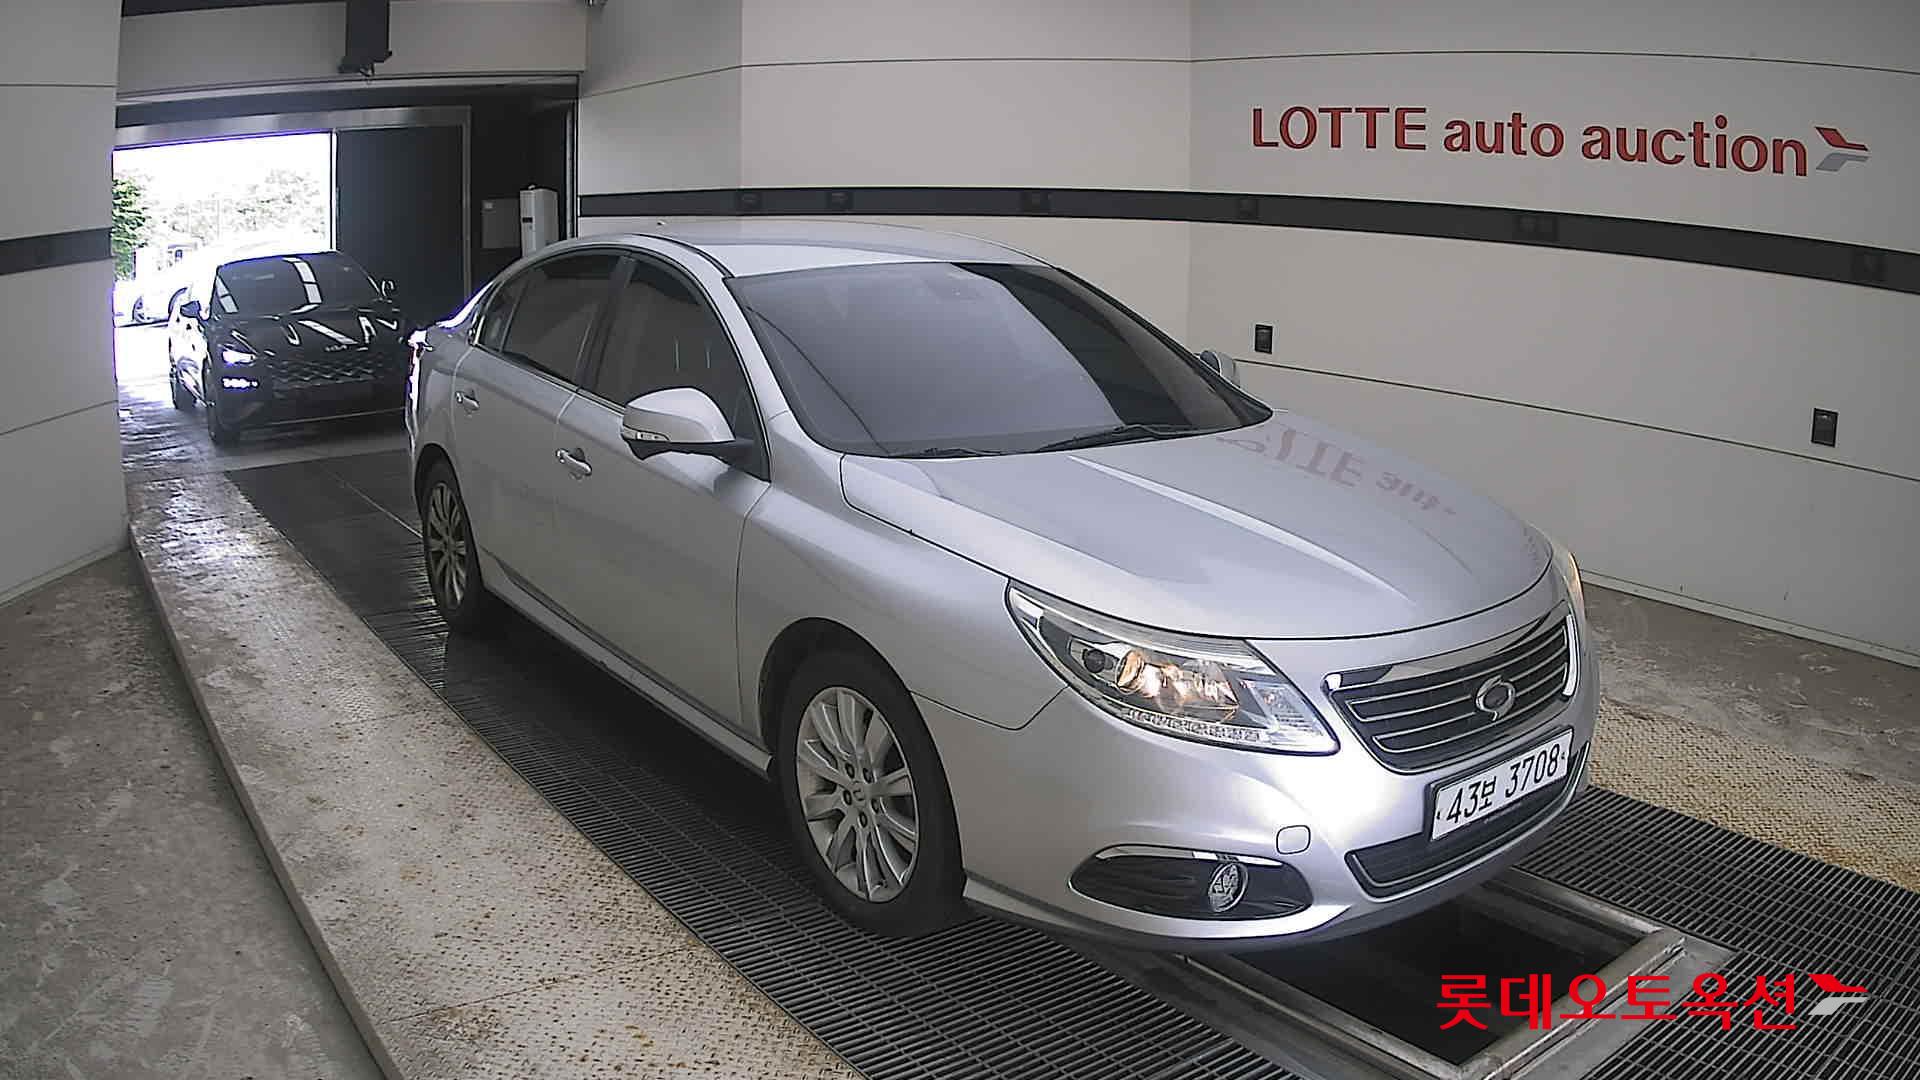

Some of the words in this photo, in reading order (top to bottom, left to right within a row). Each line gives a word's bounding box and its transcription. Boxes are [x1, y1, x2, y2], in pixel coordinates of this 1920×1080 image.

[1252, 106, 1426, 150] LOTTE
[1444, 112, 1565, 158] auto
[1581, 114, 1808, 177] auction
[1446, 776, 1497, 823] 43보
[1505, 743, 1560, 797] 3708
